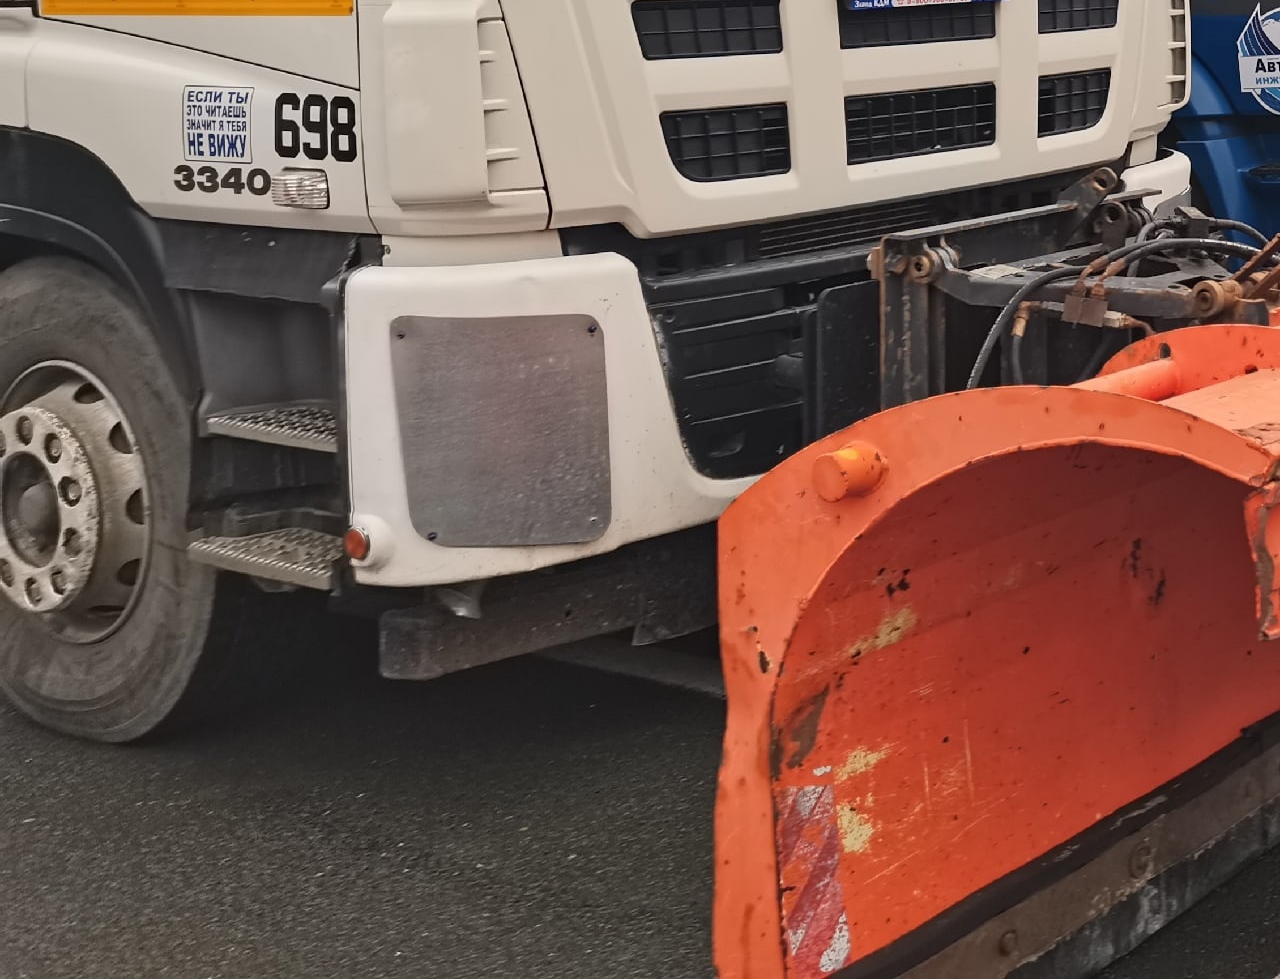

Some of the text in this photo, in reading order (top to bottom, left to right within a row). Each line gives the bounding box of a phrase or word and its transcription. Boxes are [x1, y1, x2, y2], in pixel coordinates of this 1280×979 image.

[187, 91, 249, 104] ЕСЛИ ТЫ
[187, 105, 246, 118] ЭТО ЧИТАЕШЬ
[187, 119, 247, 132] ЗНАЧИТ Я ТЕБЯ
[274, 93, 357, 162] 698
[188, 132, 246, 158] НЕ ВИЖУ
[173, 165, 271, 196] 3340
